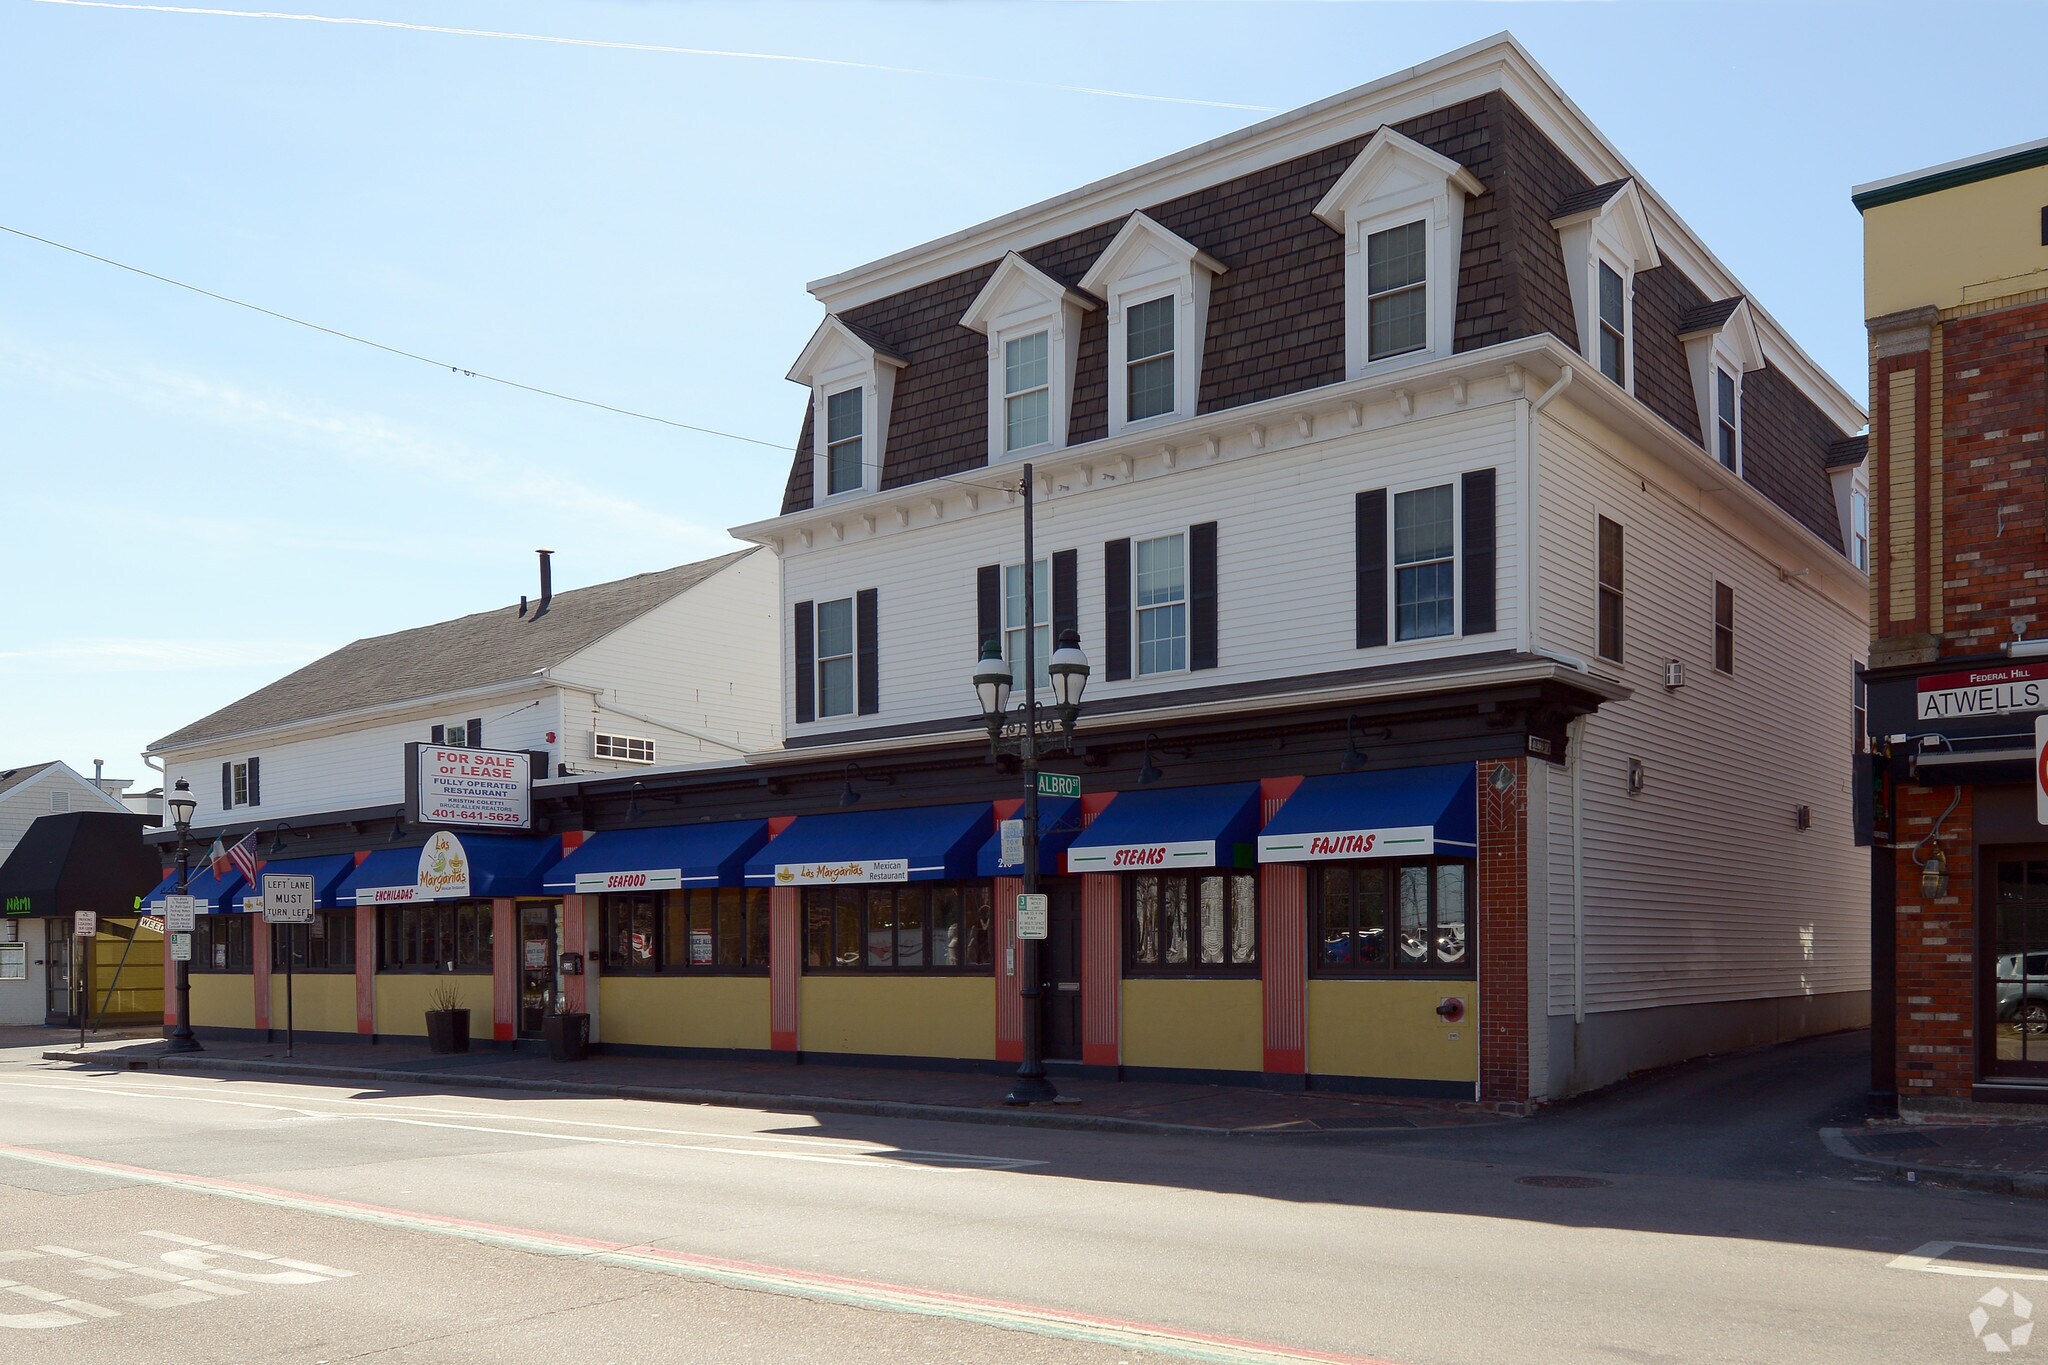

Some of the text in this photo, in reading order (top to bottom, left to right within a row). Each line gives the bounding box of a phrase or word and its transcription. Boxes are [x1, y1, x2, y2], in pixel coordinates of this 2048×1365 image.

[1924, 683, 2040, 717] ATWELLS
[437, 752, 515, 768] FOR SALE
[440, 766, 512, 778] or LEASE
[433, 778, 517, 790] FULLY OPERATED
[1038, 775, 1079, 794] ALBRO ST
[443, 786, 508, 797] RESTAURANT
[432, 809, 519, 822] 401-641-5625
[1309, 832, 1377, 855] FAJITAS
[1113, 846, 1167, 867] STEAKS
[816, 862, 864, 882] Margaritas
[873, 861, 901, 870] Mexican
[420, 868, 466, 892] Margaritas
[607, 873, 647, 889] SEAFOOD
[869, 871, 906, 881] Restaurant
[268, 880, 286, 888] LEFT
[275, 894, 302, 904] MUST
[375, 888, 414, 902] ENCHILADAS
[1020, 896, 1024, 905] 3
[6, 896, 31, 911] NAMI
[267, 908, 310, 917] TURN LEFT
